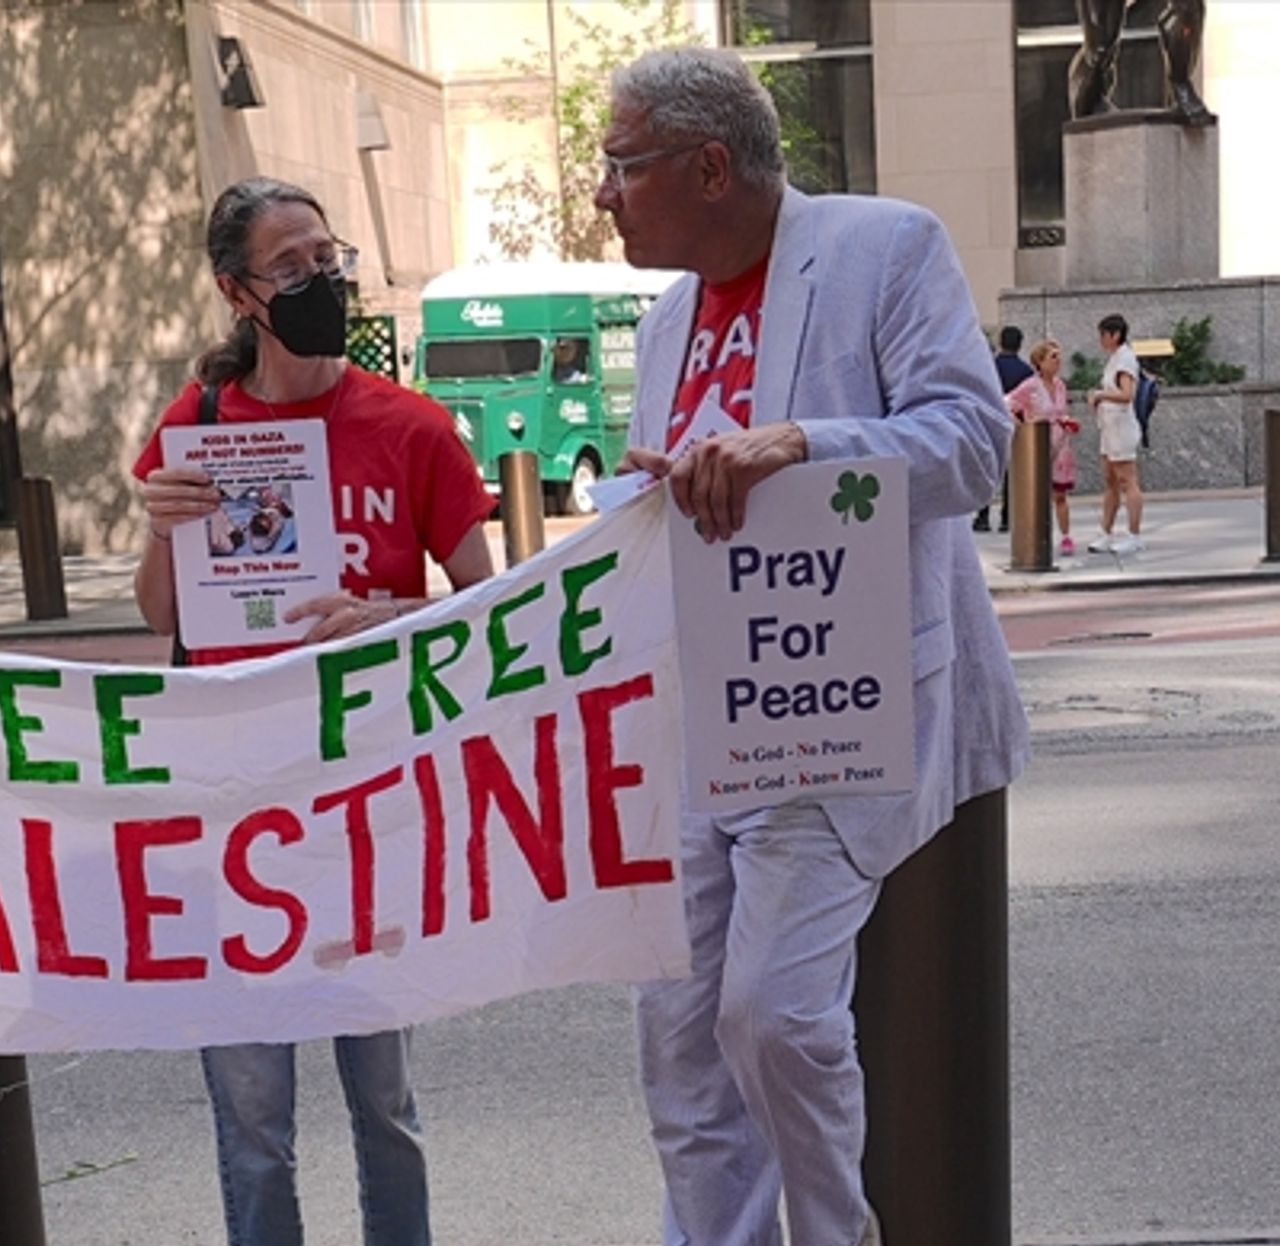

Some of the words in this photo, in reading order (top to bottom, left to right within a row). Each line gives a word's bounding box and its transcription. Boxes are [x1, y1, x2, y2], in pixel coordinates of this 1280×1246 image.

[341, 485, 395, 524] IN
[729, 546, 846, 597] Pray
[318, 551, 618, 761] FREE
[748, 616, 834, 663] For
[726, 675, 882, 724] Peace
[729, 748, 750, 764] No
[753, 745, 785, 762] God
[797, 742, 818, 758] No
[822, 740, 862, 755] Peace
[710, 779, 751, 795] Know
[755, 774, 785, 791] God
[799, 771, 840, 786] Know
[844, 767, 884, 782] Peace
